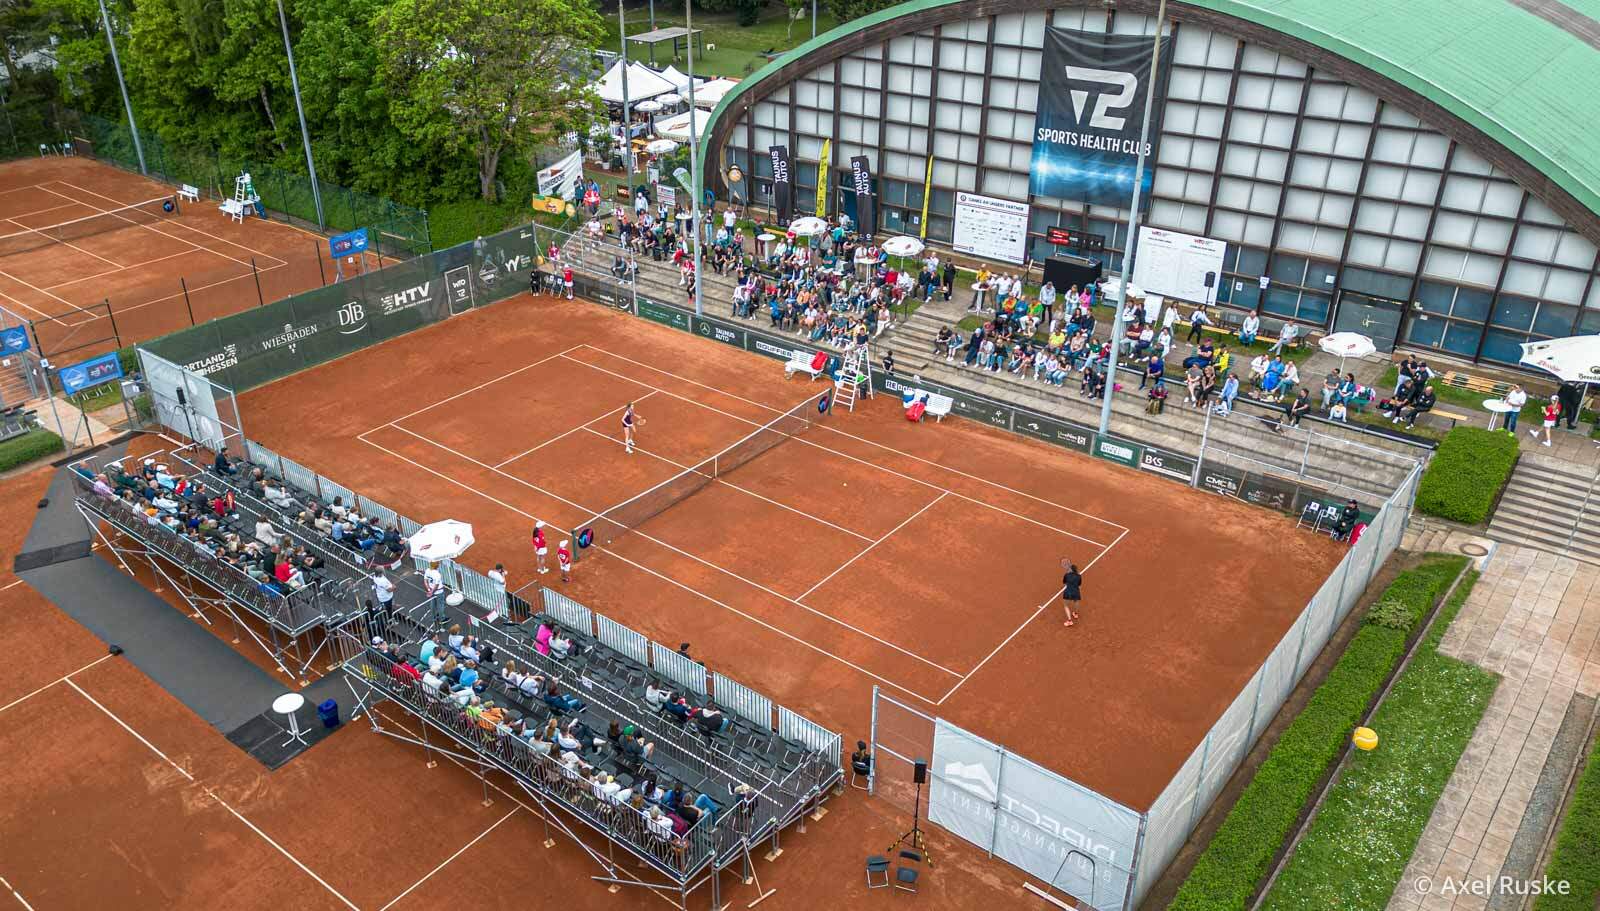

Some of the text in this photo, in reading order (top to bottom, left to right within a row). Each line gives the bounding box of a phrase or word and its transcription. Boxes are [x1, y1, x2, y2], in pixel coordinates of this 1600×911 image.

[1037, 127, 1078, 146] SPORTS
[1080, 133, 1120, 152] HEALTH
[771, 150, 782, 184] TAUNUS
[779, 160, 789, 184] AUTO
[852, 161, 865, 196] TAUNUS
[861, 171, 871, 196] AUTO
[394, 281, 430, 306] HTV
[338, 301, 365, 326] DTB
[262, 324, 318, 350] WIESBADEN
[715, 327, 736, 339] TAUNUS
[715, 333, 730, 342] AUTO
[182, 353, 225, 371] ORTLAND
[204, 357, 238, 375] HESSEN
